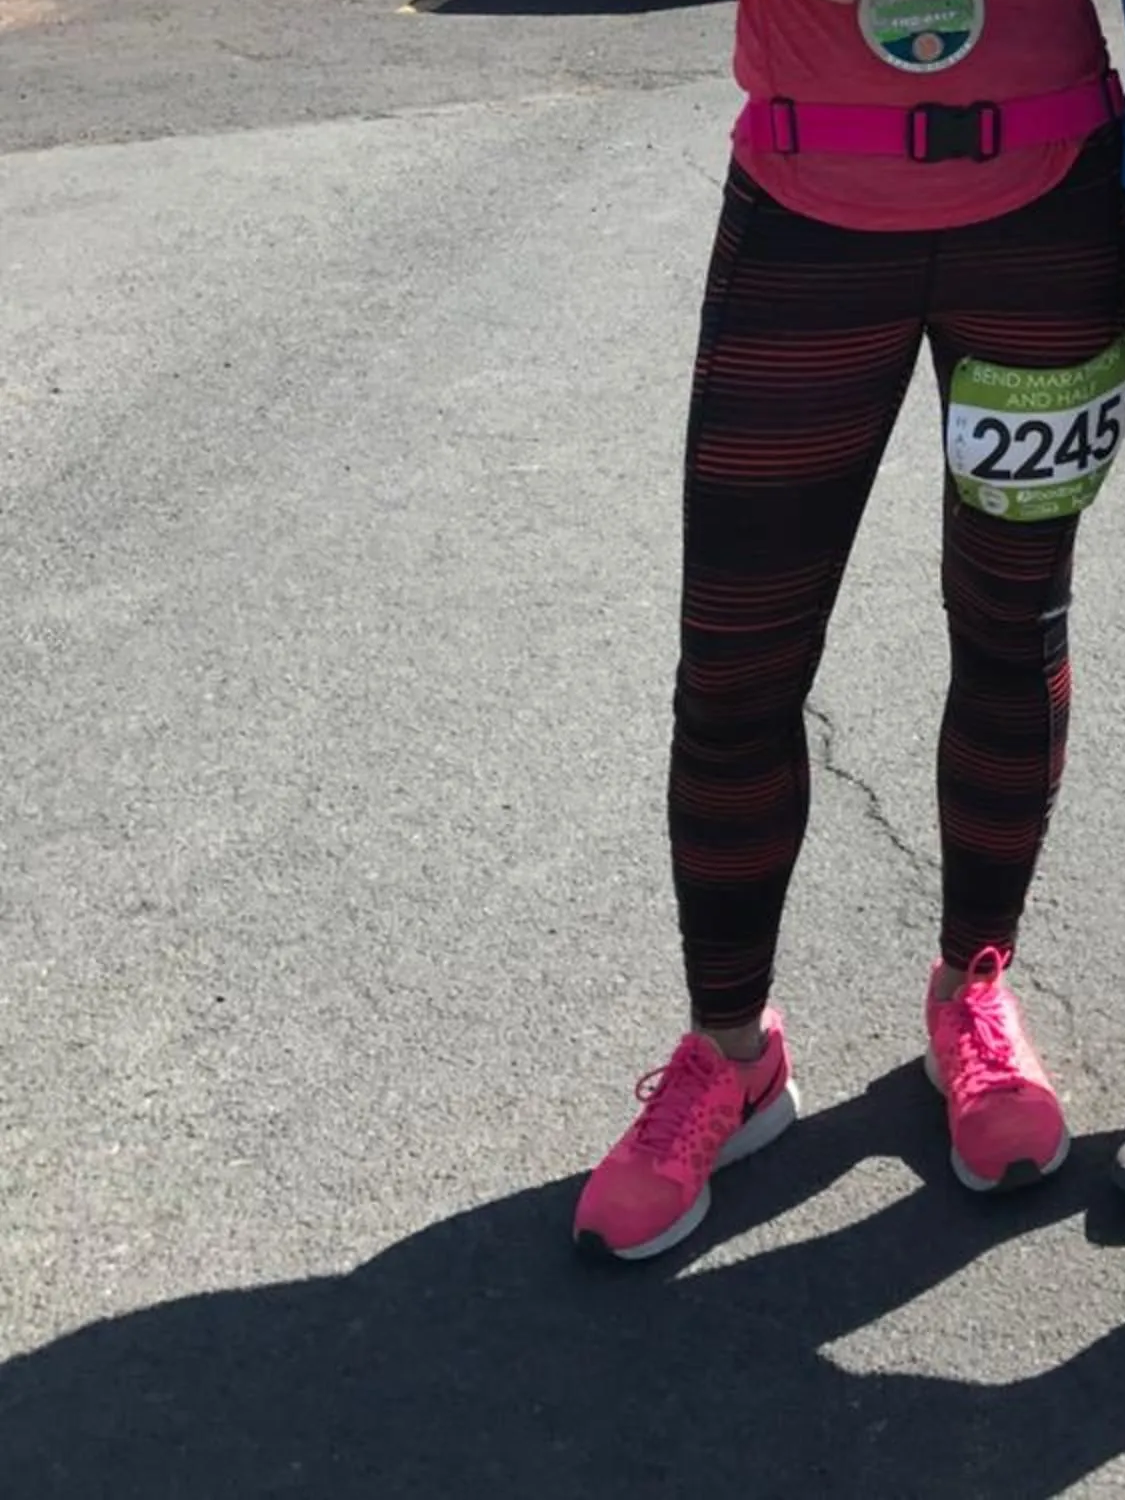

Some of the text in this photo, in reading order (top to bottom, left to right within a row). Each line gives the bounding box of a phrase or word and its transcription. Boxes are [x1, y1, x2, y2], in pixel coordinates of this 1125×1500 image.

[972, 364, 1021, 388] BEND
[1005, 393, 1052, 408] AND
[970, 394, 1122, 480] 2245
